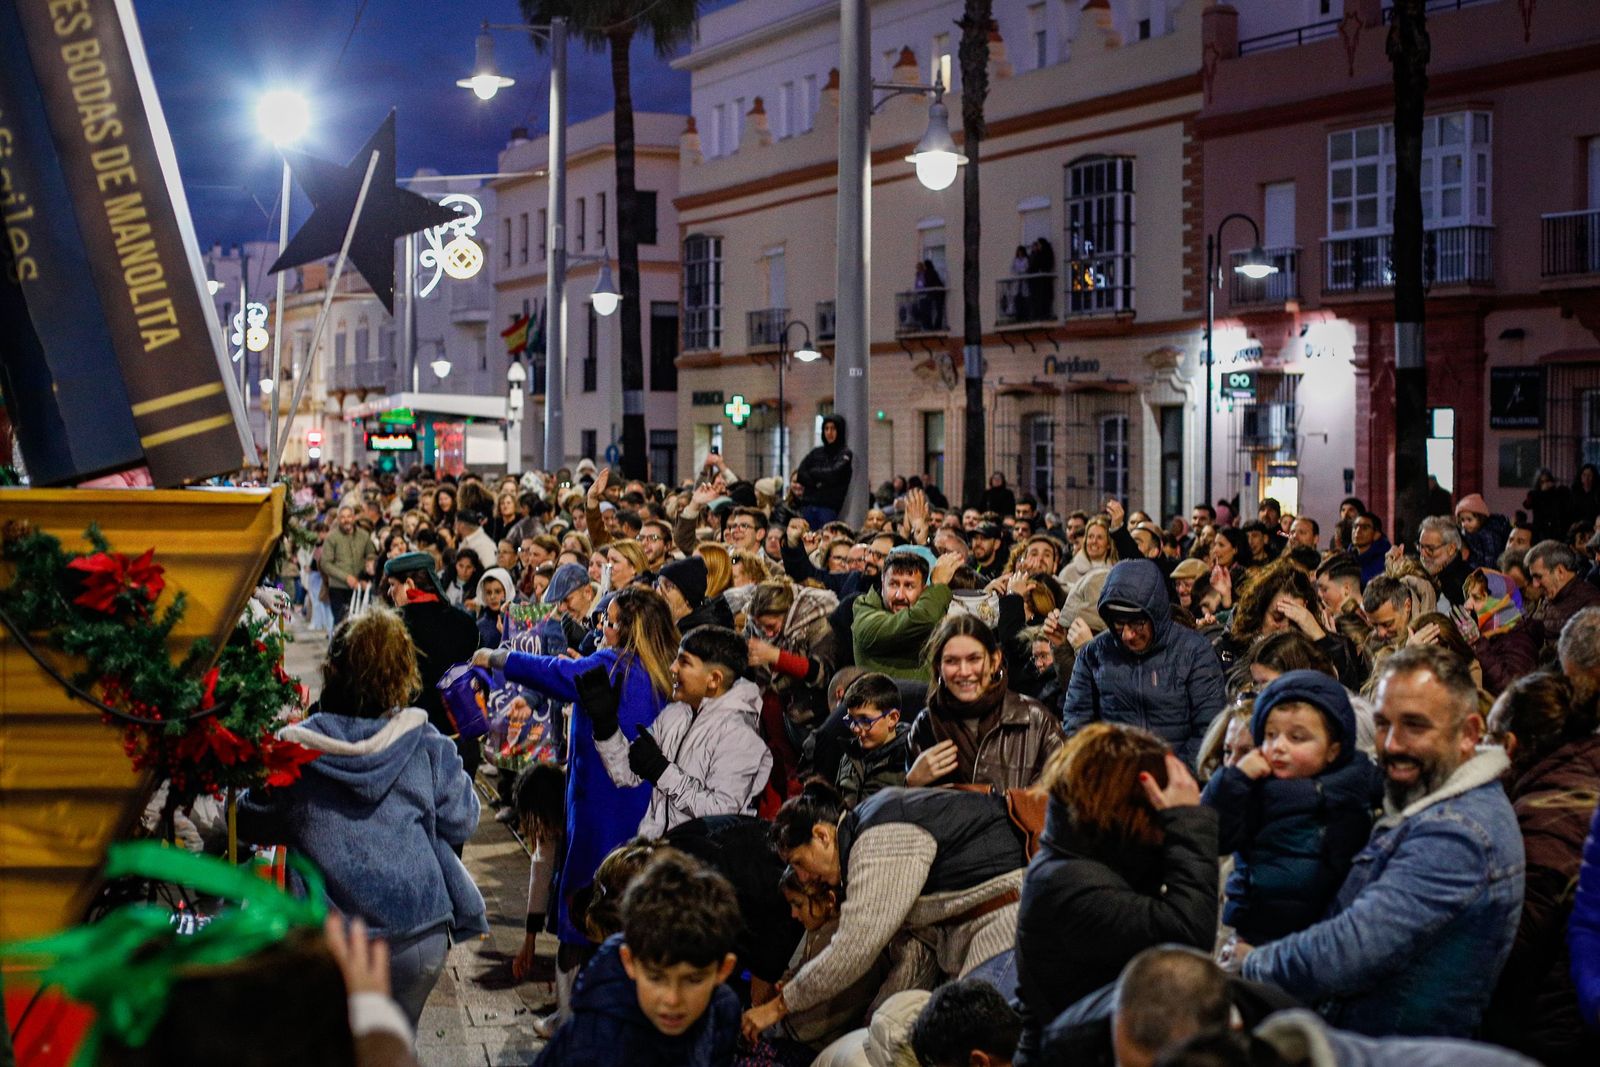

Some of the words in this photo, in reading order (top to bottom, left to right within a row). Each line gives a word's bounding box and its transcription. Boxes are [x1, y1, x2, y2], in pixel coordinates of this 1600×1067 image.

[61, 38, 123, 143] BODAS
[90, 144, 137, 192] DE
[104, 192, 181, 352] MANOLITA
